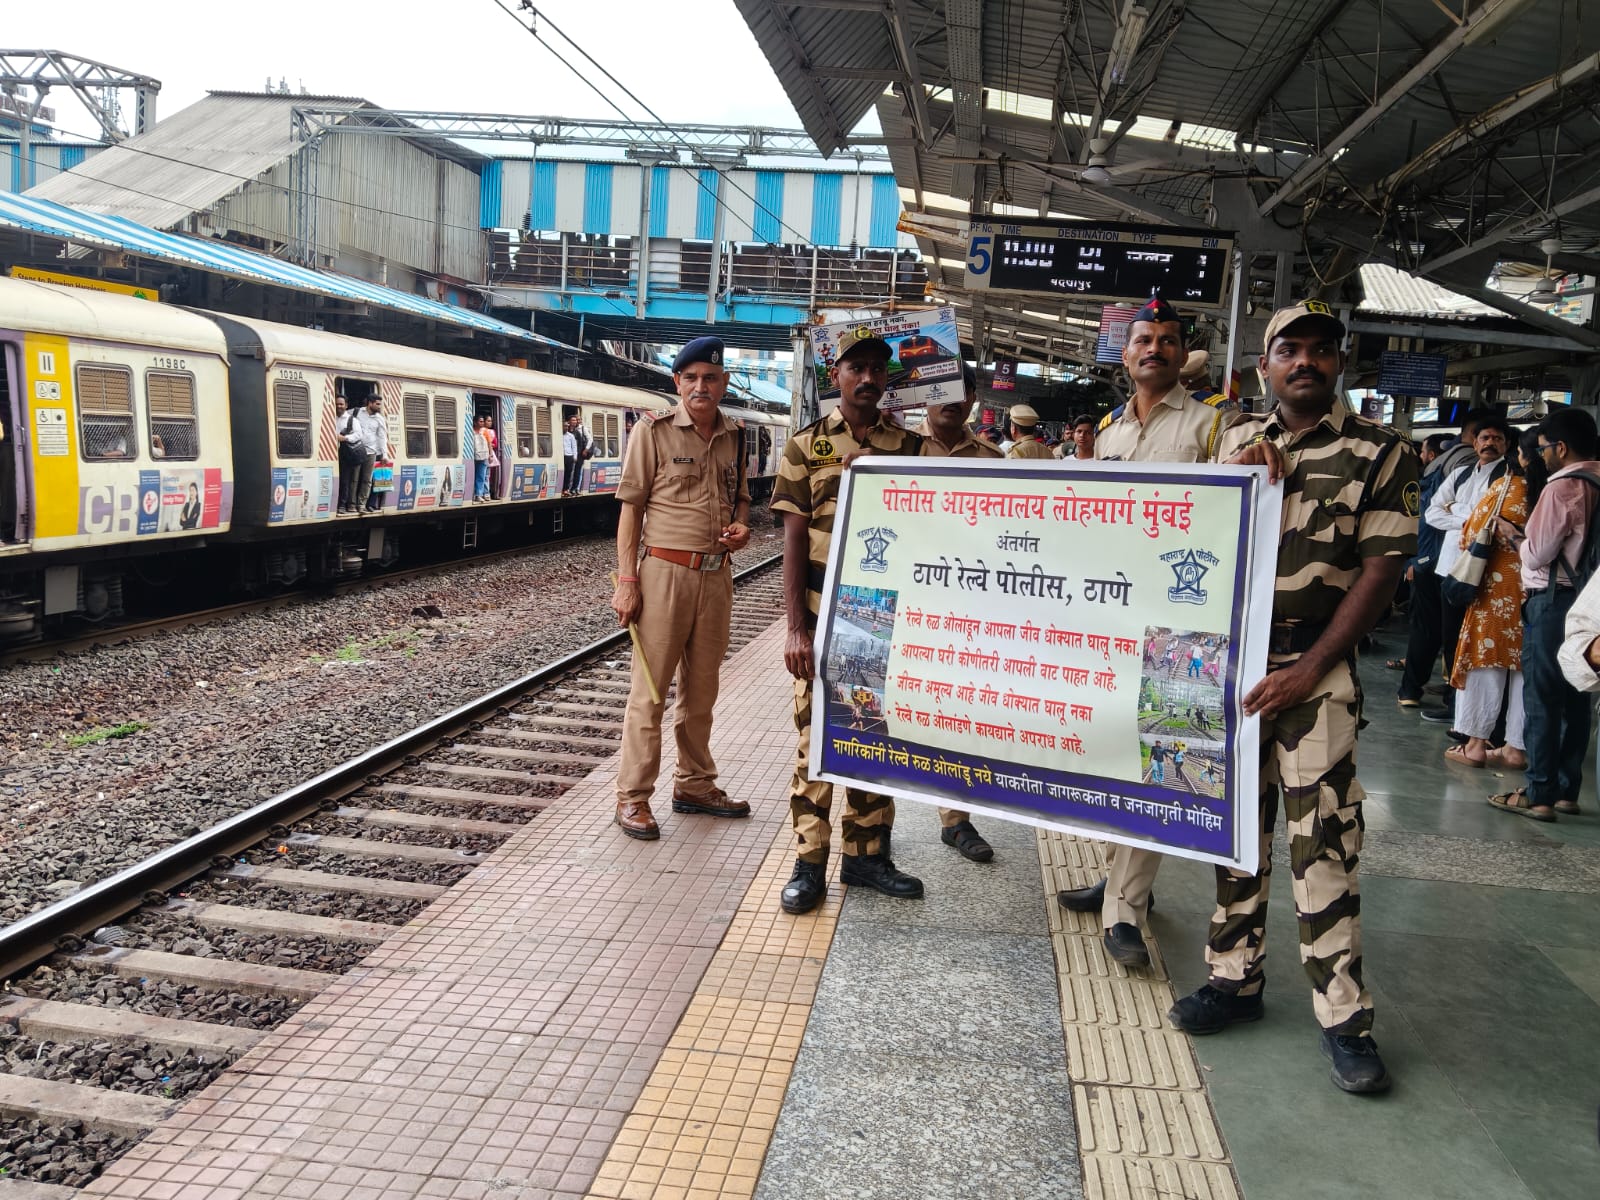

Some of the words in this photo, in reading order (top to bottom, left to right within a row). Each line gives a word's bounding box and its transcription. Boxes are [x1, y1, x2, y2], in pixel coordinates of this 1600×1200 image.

[970, 222, 980, 232] PF
[982, 223, 994, 234] No.
[1001, 225, 1021, 235] TIME
[1058, 228, 1120, 241] DESTINATION
[1132, 233, 1157, 243] TYPE
[967, 236, 991, 275] 5
[153, 356, 186, 369] 1198C
[1001, 363, 1011, 375] 5
[280, 370, 303, 380] 1030A
[1369, 400, 1378, 412] 6
[882, 479, 937, 513] पोलीस
[941, 491, 1048, 527] आयुक्तालय
[1052, 486, 1137, 528] लोहमार्ग
[1142, 490, 1194, 538] मुंबई
[996, 530, 1040, 553] अंतर्गत
[1196, 548, 1220, 567] पोलीस
[913, 556, 952, 588] ठाणे
[955, 557, 990, 592] रेल्वे
[996, 562, 1073, 606] पोलीस,
[1084, 572, 1133, 606] ठाणे
[906, 606, 923, 627] रेल्वे
[926, 614, 941, 630] रुळ
[943, 611, 981, 642] ओलांडून
[984, 622, 1016, 641] आपला
[1020, 620, 1041, 643] जीव
[1045, 624, 1083, 649] धोक्यात
[1087, 634, 1110, 661] घालू
[1114, 637, 1139, 656] नका.
[901, 643, 935, 663] आपल्या
[938, 644, 955, 667] घरी
[958, 646, 1000, 673] कोणीतरी
[1003, 656, 1037, 678] आपली
[1040, 663, 1059, 680] वाट
[1062, 667, 1090, 687] पाहत
[1093, 667, 1117, 692] आहे.
[897, 670, 922, 693] जीवन
[925, 680, 954, 705] अमूल्य
[956, 681, 976, 704] आहे
[979, 683, 999, 706] जीव
[1003, 687, 1041, 714] धोक्यात
[1044, 699, 1067, 726] घालू
[1070, 704, 1093, 722] नका
[895, 702, 912, 723] रेल्वे
[916, 710, 930, 728] रुळ
[933, 709, 972, 735] ओलांडणे
[975, 721, 1015, 743] कायद्याने
[1020, 730, 1056, 750] अपराध
[1060, 733, 1086, 756] आहे.
[833, 737, 887, 763] नागरिकांनी
[887, 743, 909, 768] रेल्वे
[912, 754, 931, 772] रुळ
[933, 754, 974, 788] ओलांडू
[974, 764, 992, 785] नये
[994, 772, 1043, 795] याकरीता
[1046, 781, 1107, 808] जागरूकता
[1110, 793, 1120, 810] व
[1123, 796, 1183, 826] जनजागृती
[1185, 804, 1223, 832] मोहिम
